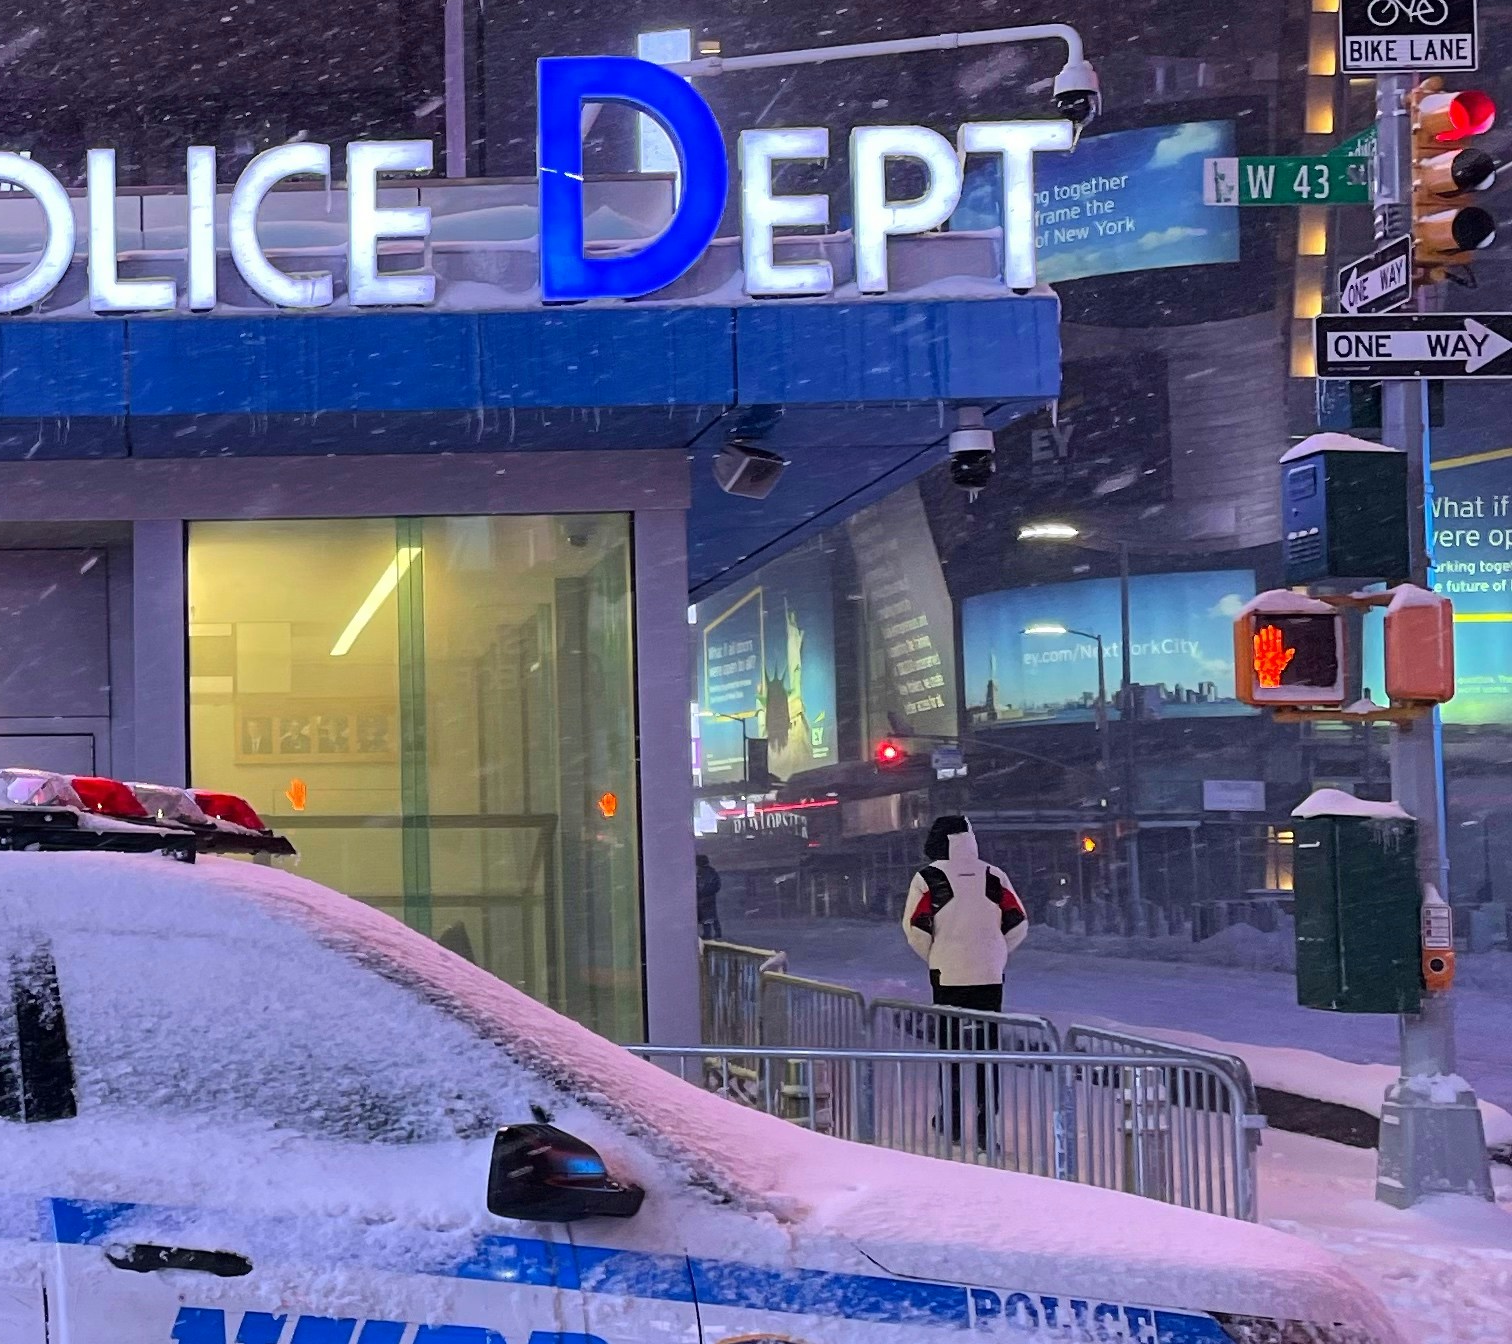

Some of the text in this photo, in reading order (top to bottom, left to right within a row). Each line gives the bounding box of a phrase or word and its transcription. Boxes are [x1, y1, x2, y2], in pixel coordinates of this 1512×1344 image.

[1349, 39, 1468, 62] BIKE LANE
[536, 55, 1074, 304] DEPT
[1054, 174, 1129, 202] together
[1246, 164, 1276, 199] W
[1292, 164, 1330, 199] 43
[1086, 199, 1115, 218] the
[1035, 215, 1137, 249] of New York
[1348, 258, 1404, 307] ONE WAY
[1334, 333, 1491, 358] ONE WAY
[1493, 495, 1510, 517] if
[1446, 579, 1490, 593] future
